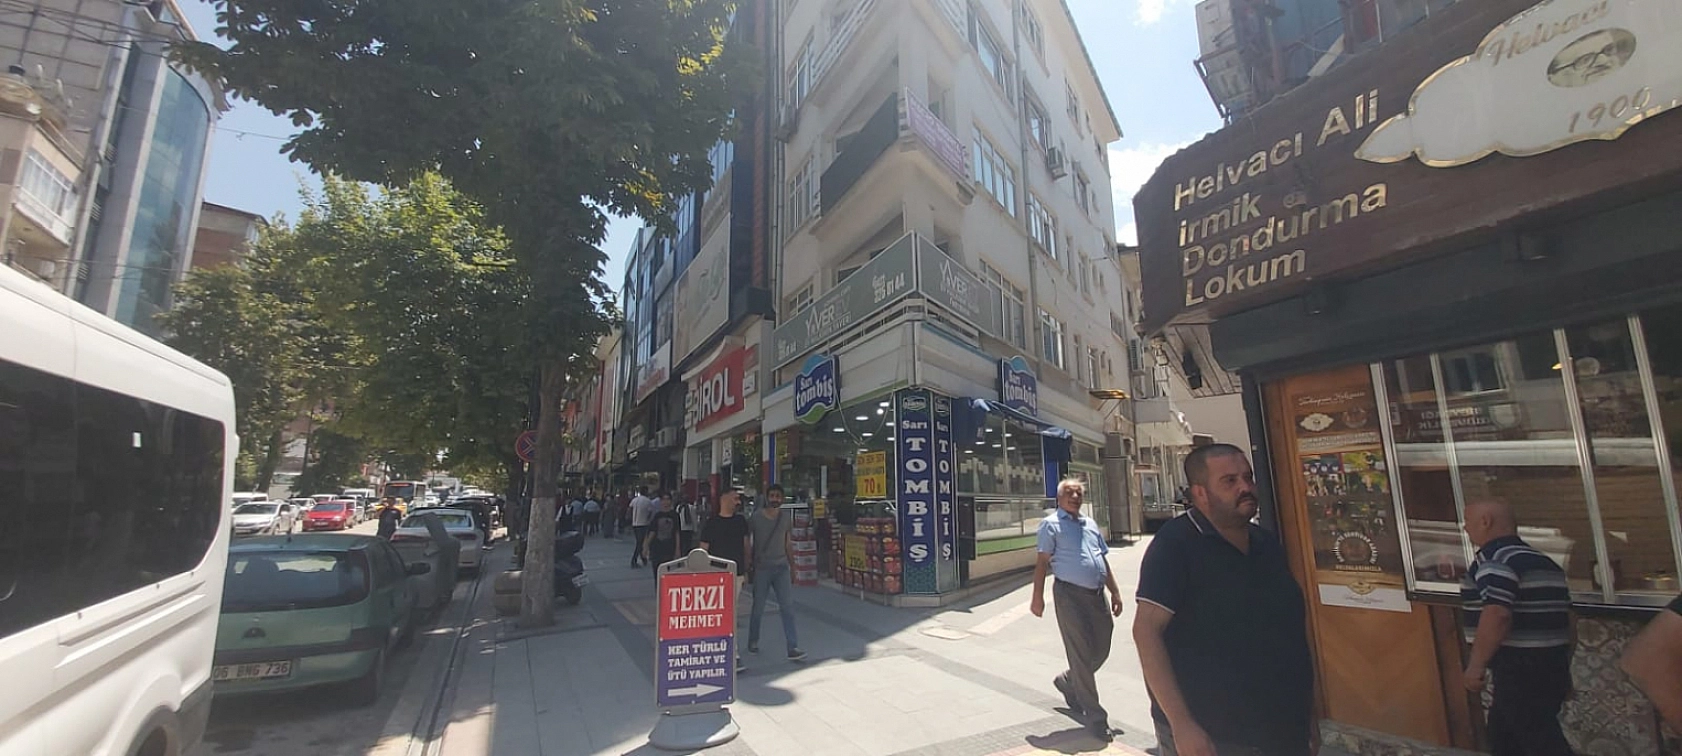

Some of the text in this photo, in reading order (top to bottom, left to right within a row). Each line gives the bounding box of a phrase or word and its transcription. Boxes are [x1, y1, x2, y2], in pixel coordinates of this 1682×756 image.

[1568, 86, 1651, 133] 1900
[1174, 88, 1378, 211] Helvacı Ali
[1183, 183, 1388, 277] Dondurma
[1186, 249, 1306, 306] Lokum
[796, 374, 833, 411] tombiş
[1005, 380, 1037, 415] tombiş
[902, 420, 928, 430] Sarı
[864, 477, 875, 494] 70
[904, 437, 930, 562] TOMBİŞ
[939, 438, 951, 560] TOMBİŞ
[668, 577, 725, 612] TERZİ
[669, 614, 723, 630] MEHMET
[667, 655, 726, 668] TAMİRAT VE
[668, 640, 727, 655] HER TÜRLÜ
[266, 662, 288, 675] 736
[667, 669, 687, 681] ÜTÜ
